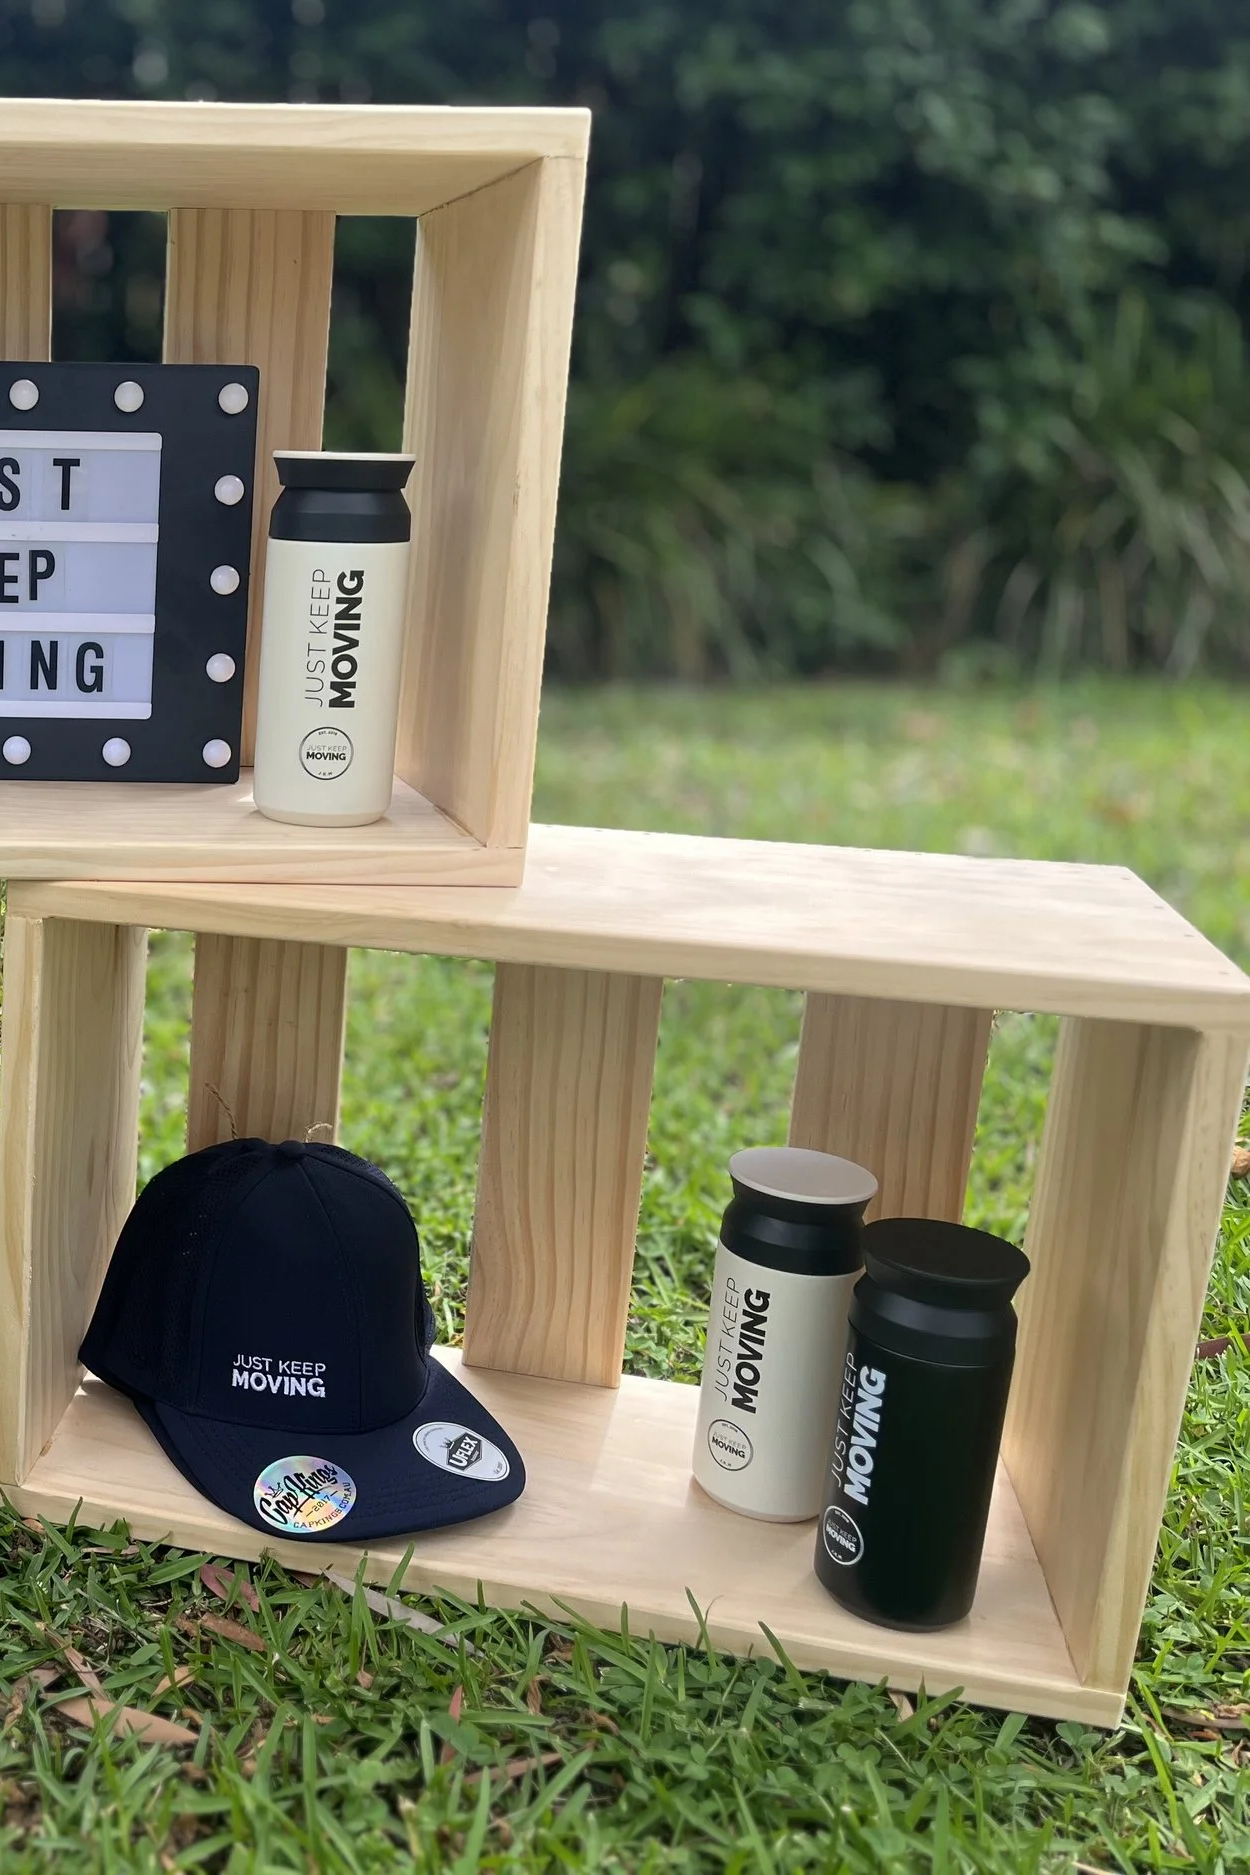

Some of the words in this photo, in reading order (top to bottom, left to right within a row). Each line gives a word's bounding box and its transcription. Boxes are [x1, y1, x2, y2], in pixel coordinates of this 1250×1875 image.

[309, 569, 331, 634] KEEP
[329, 570, 364, 708] MOVING
[305, 642, 326, 707] JUST
[306, 751, 346, 761] MOVING
[721, 1277, 740, 1339] KEEP
[233, 1353, 273, 1372] JUST
[278, 1360, 326, 1376] KEEP
[714, 1338, 733, 1402] JUST
[731, 1287, 771, 1414] MOVING
[231, 1368, 326, 1398] MOVING
[839, 1352, 859, 1420] KEEP
[449, 1436, 479, 1467] UFLEX
[712, 1436, 746, 1459] MOVING
[831, 1418, 849, 1488] JUST
[843, 1365, 887, 1506] MOVING
[311, 1495, 330, 1512] 2017
